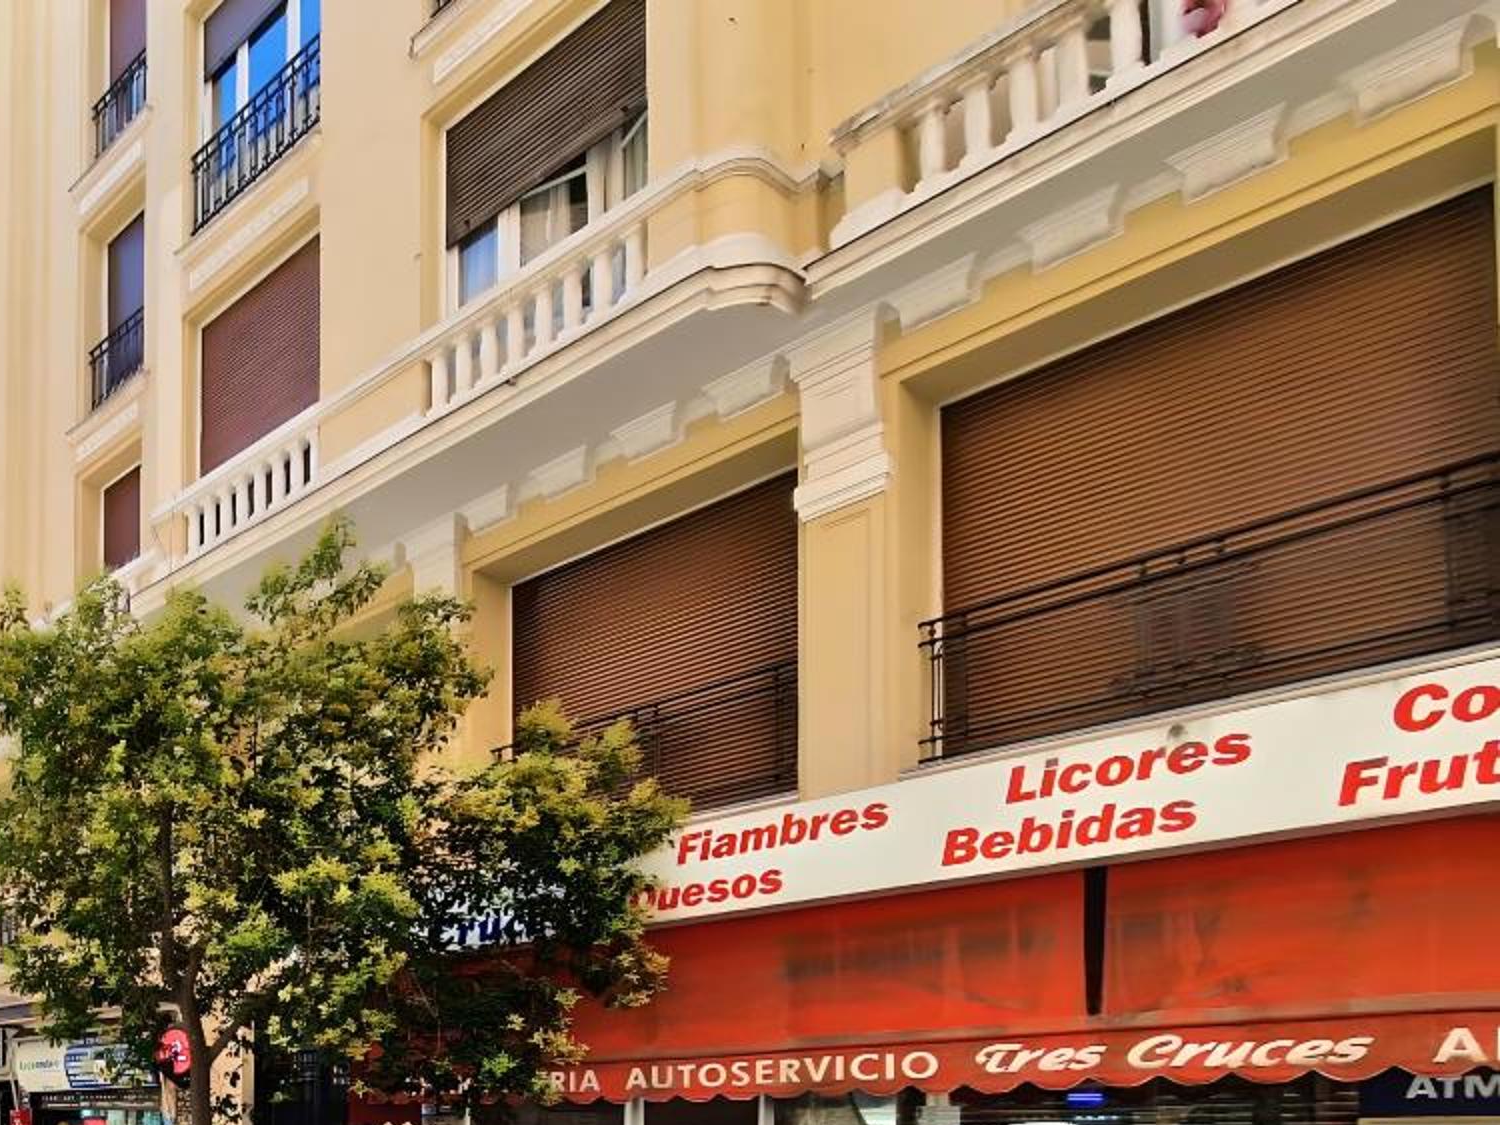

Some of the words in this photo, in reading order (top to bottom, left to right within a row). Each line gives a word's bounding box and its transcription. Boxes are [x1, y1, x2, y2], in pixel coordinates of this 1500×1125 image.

[1393, 683, 1500, 733] Co
[1005, 732, 1252, 805] Licores
[677, 802, 889, 866] Fiambres
[940, 800, 1198, 867] Bebidas
[625, 1050, 939, 1092] AUTOSERVICIO
[975, 1042, 1108, 1073] Tres
[1126, 1032, 1376, 1069] Cruces
[1432, 1026, 1500, 1064] A
[1404, 1072, 1500, 1100] ATM
